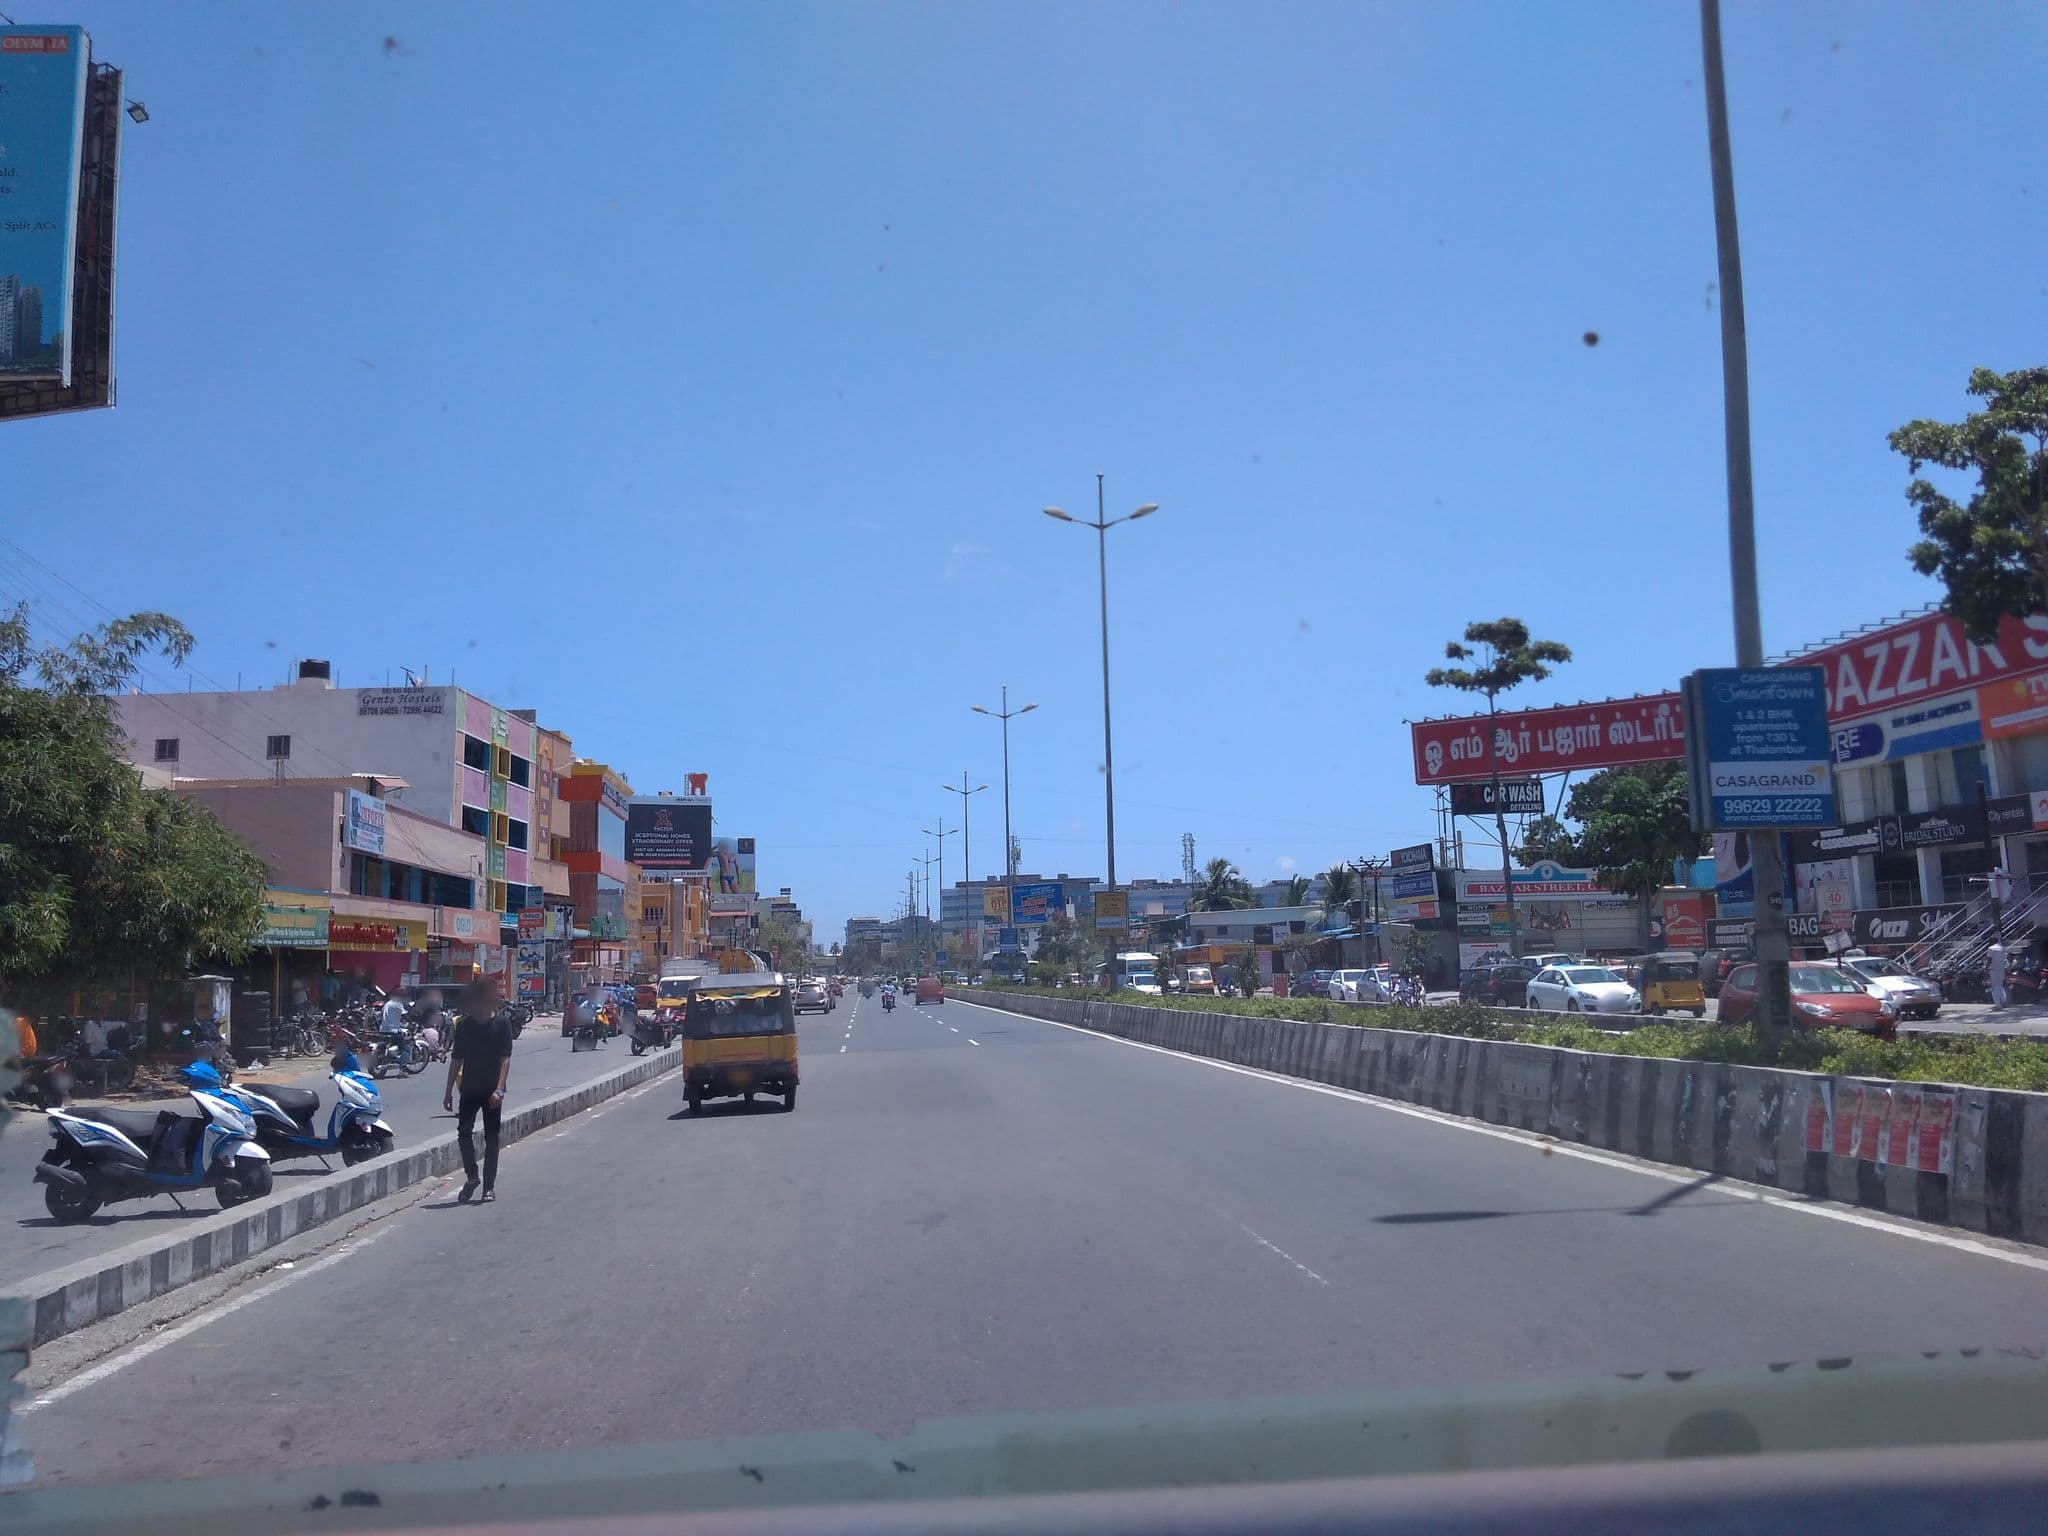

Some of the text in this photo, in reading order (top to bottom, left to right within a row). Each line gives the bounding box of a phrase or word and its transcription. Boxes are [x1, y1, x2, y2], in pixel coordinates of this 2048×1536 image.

[3, 37, 67, 49] OLYMIA
[1739, 672, 1812, 683] CASAGRAND
[362, 692, 441, 706] Gents Hostels
[1767, 710, 1794, 719] BHK
[1732, 723, 1799, 733] apartments
[1450, 725, 1483, 761] எம்
[1494, 721, 1530, 763] ஆர்
[1537, 713, 1600, 756] பஜார்
[1736, 732, 1764, 743] from
[1729, 745, 1742, 755] at
[1715, 774, 1815, 788] CASAGRAND
[1508, 784, 1541, 802] WASH
[1510, 802, 1542, 812] DETAILING
[1723, 798, 1823, 814] 99629 22222
[1724, 813, 1823, 823] www.casagrand.co.in
[1987, 807, 2025, 823] City rentals
[1903, 824, 1966, 842] BRIDAL STUDIO
[1479, 882, 1532, 894] BAZAR
